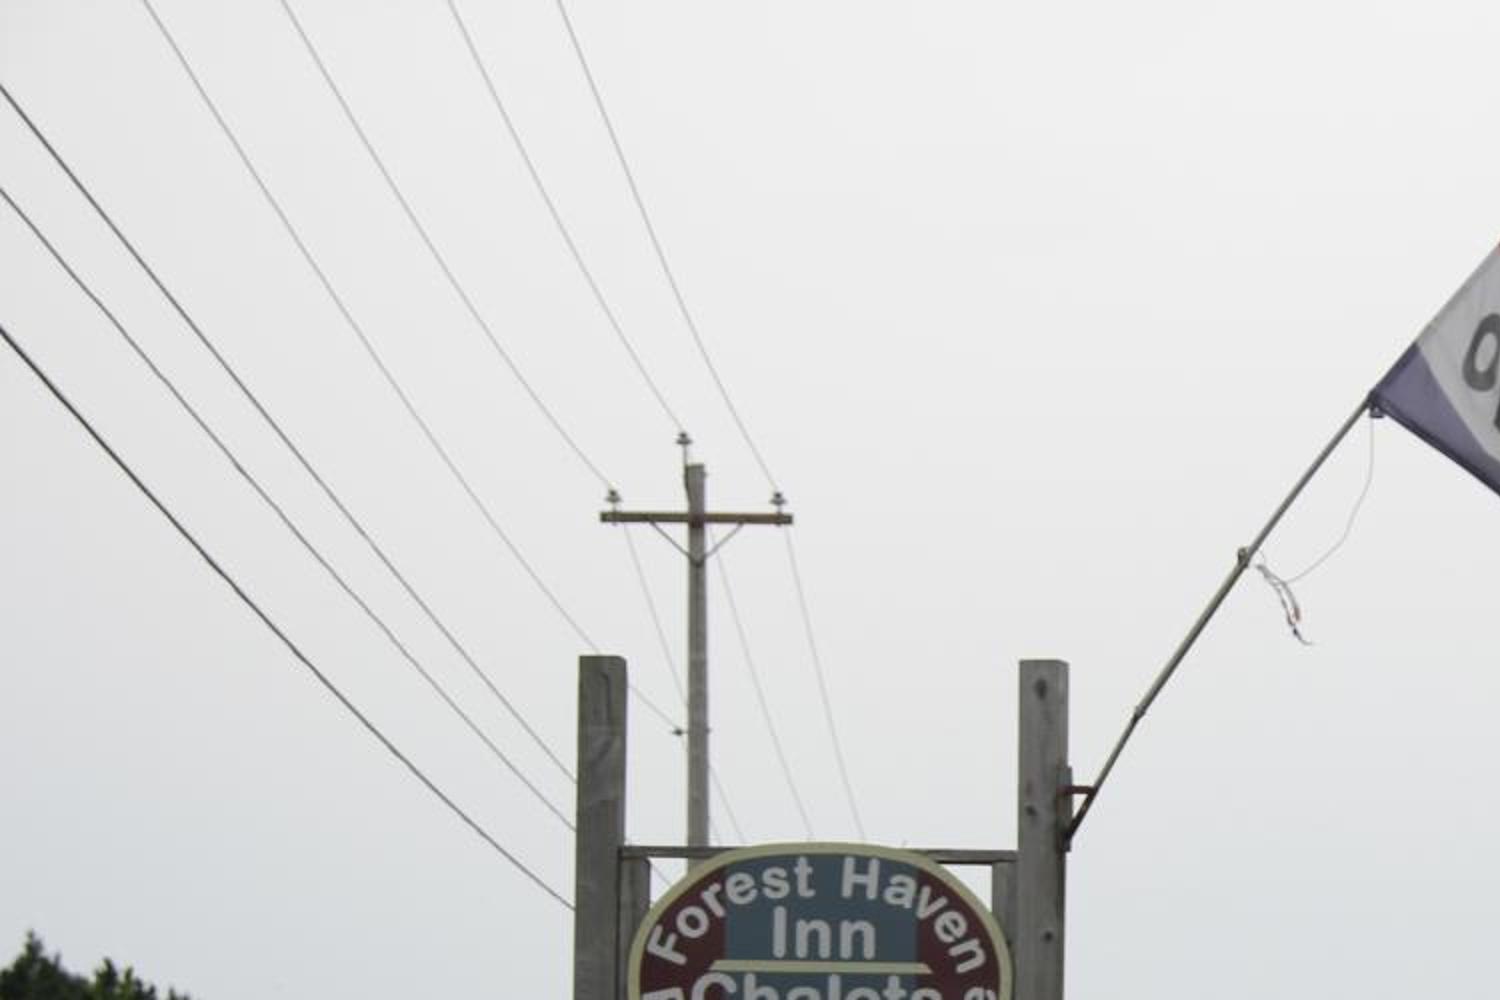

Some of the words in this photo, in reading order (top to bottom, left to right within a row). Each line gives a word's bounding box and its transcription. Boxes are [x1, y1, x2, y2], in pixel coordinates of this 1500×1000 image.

[646, 856, 816, 966] Forest
[841, 857, 988, 974] Haven
[772, 906, 877, 960] Inn
